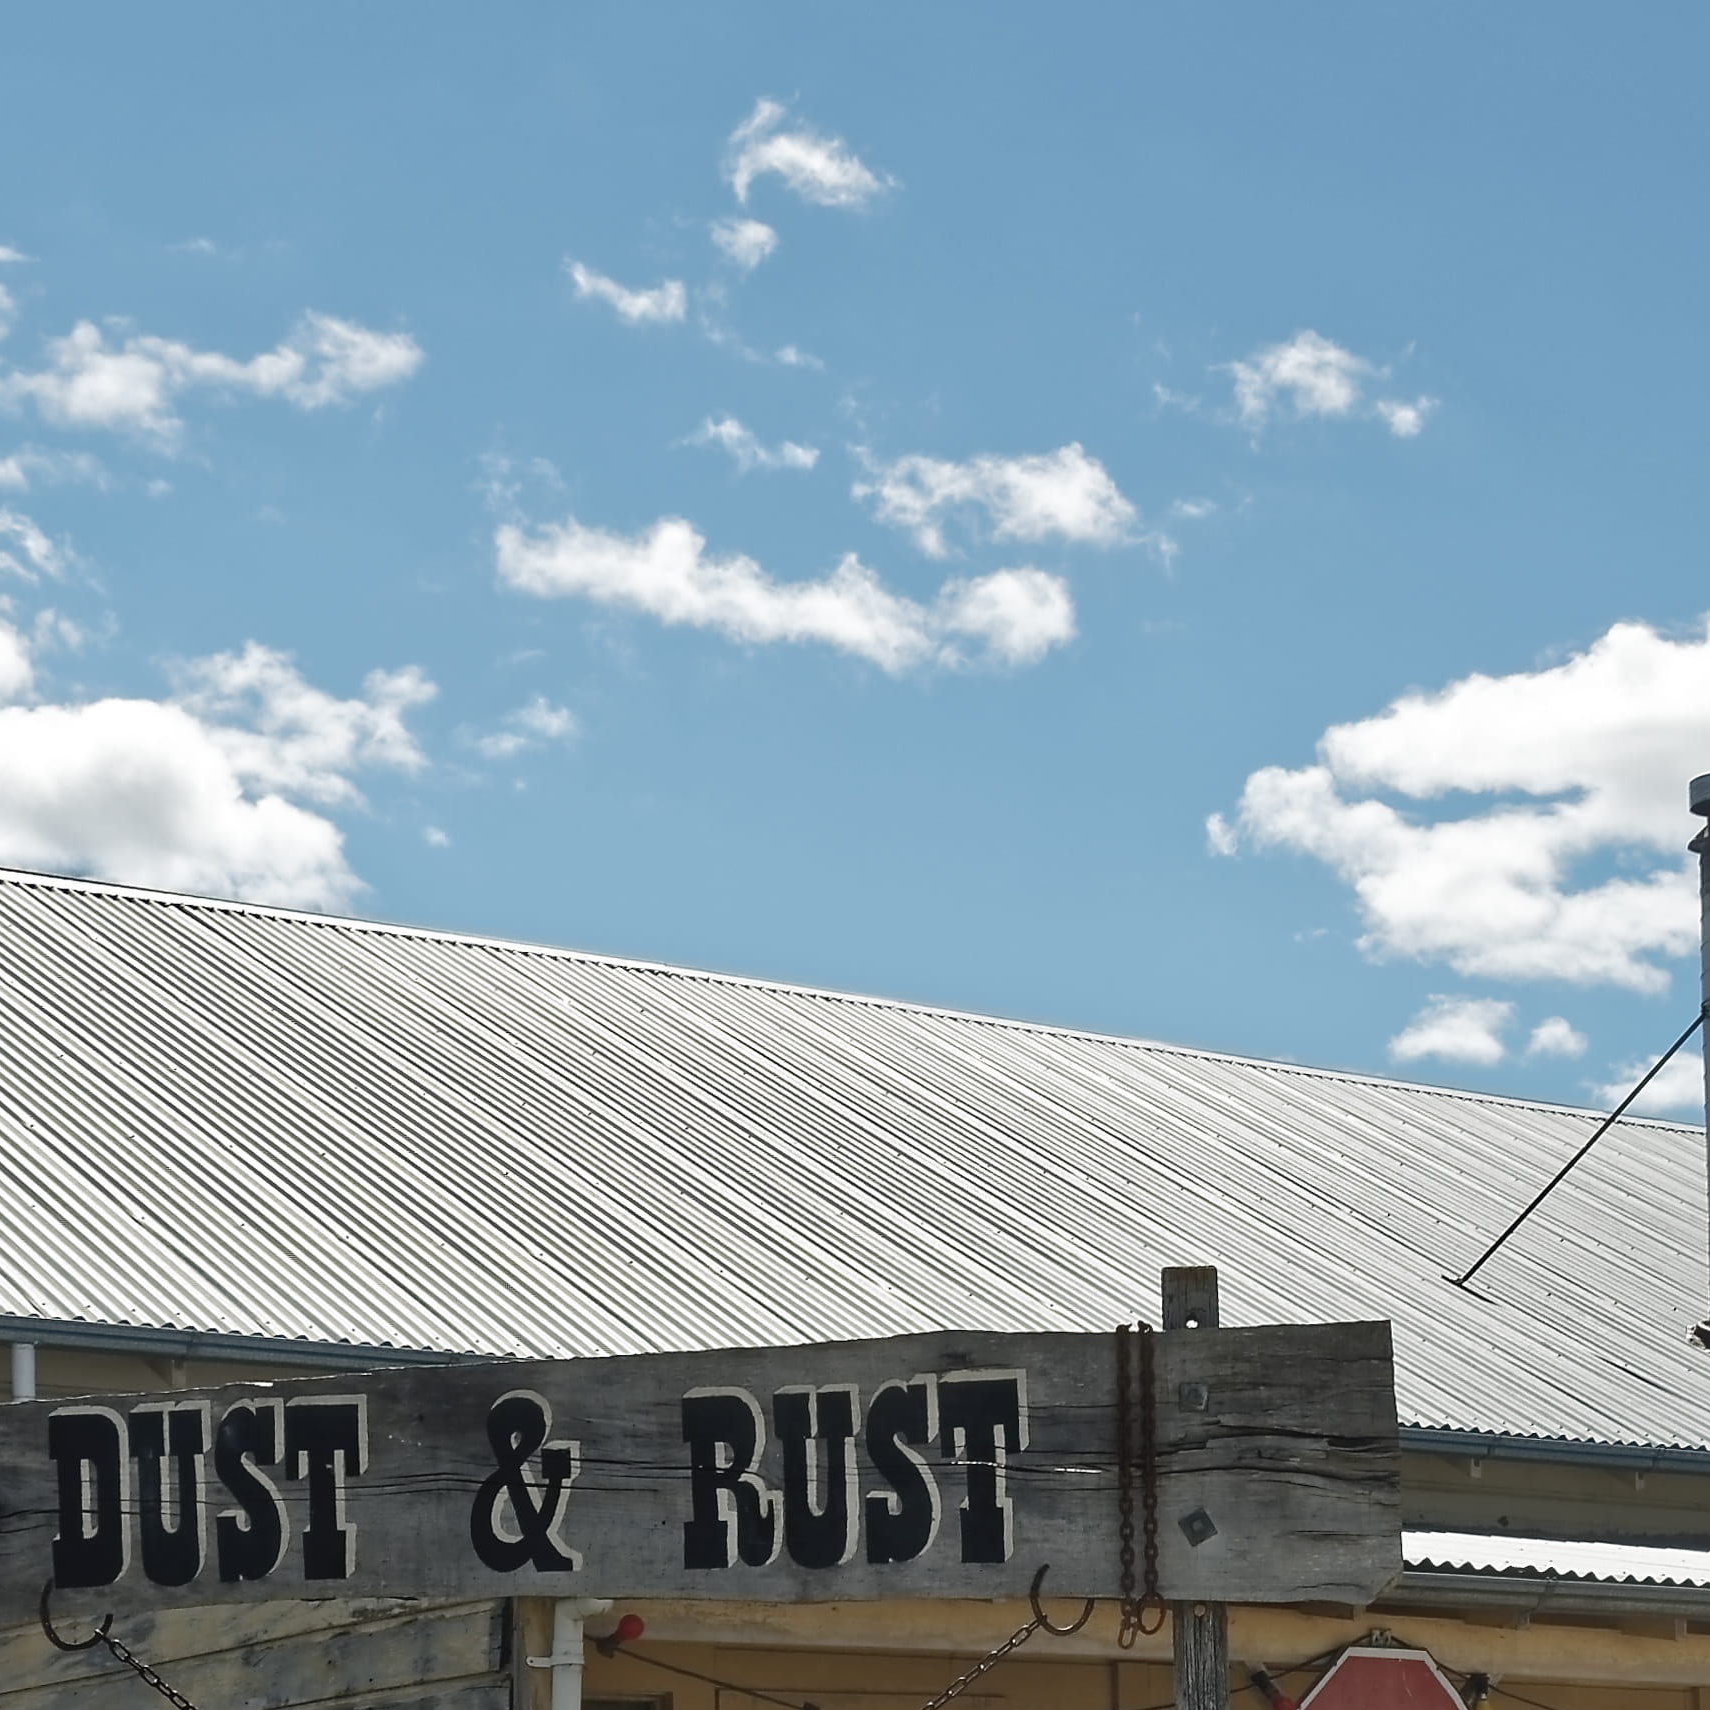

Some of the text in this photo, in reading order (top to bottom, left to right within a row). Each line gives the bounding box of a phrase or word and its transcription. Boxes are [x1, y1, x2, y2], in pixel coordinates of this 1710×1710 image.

[48, 1368, 1027, 1588] DUST & RUST
